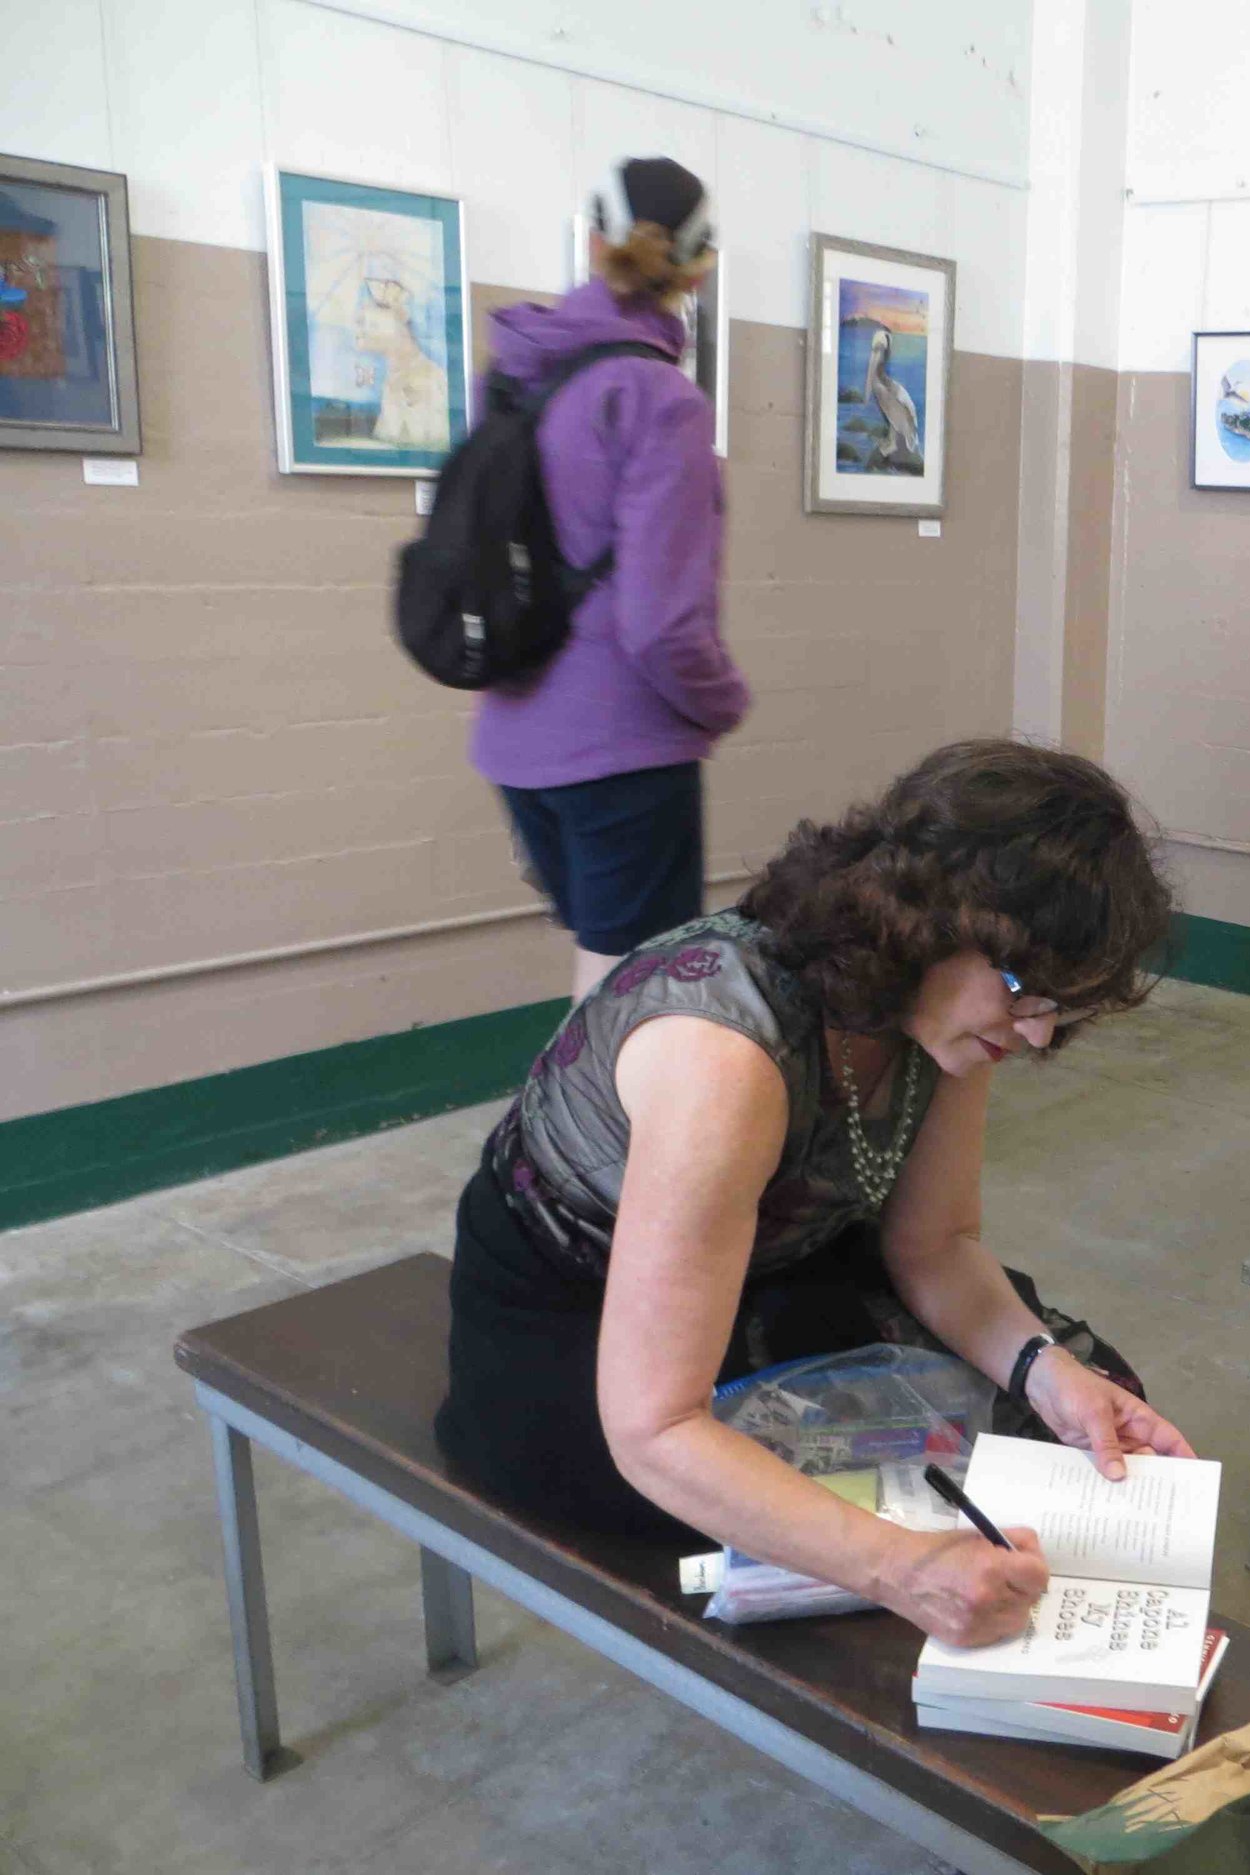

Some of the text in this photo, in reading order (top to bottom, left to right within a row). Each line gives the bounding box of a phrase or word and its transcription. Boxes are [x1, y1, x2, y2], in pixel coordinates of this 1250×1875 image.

[1053, 1588, 1087, 1641] Shoes
[1080, 1602, 1112, 1628] My
[1108, 1588, 1140, 1651] Shines
[1139, 1588, 1170, 1650] Capone
[1165, 1608, 1190, 1630] Al
